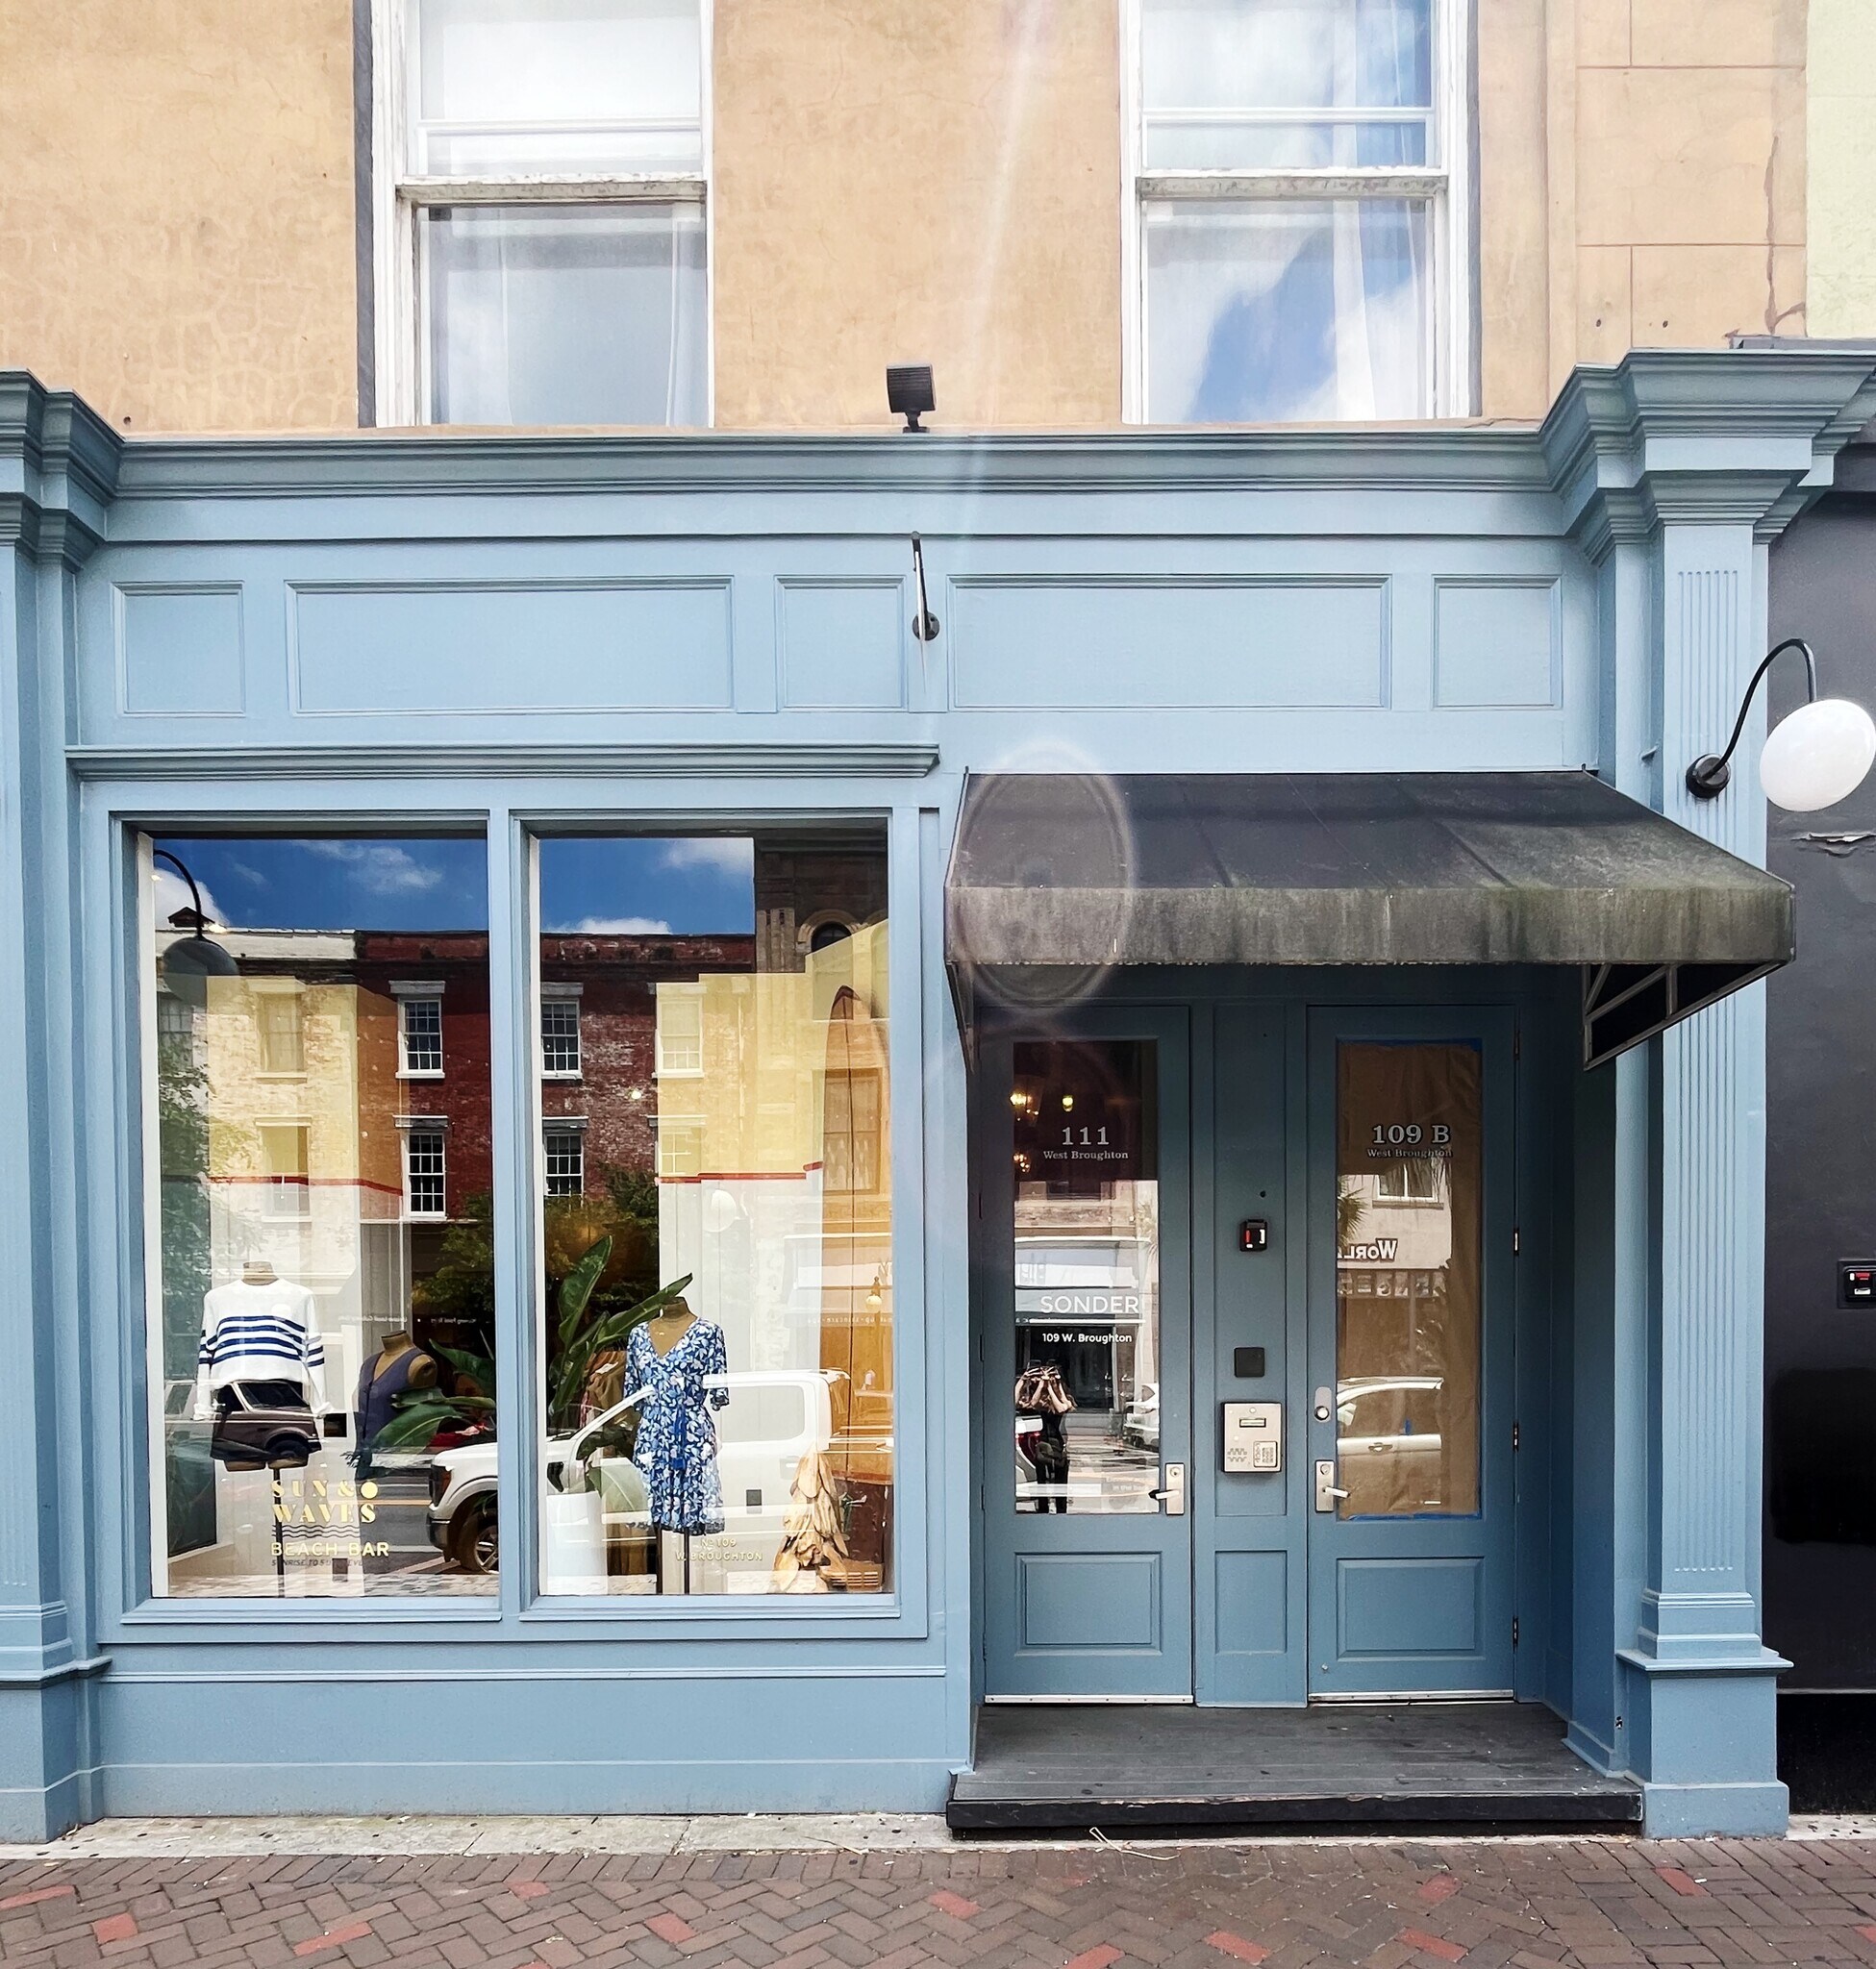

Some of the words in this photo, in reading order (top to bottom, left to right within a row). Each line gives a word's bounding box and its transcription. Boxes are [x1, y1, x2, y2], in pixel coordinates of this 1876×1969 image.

[1062, 1126, 1110, 1145] 111
[1373, 1124, 1422, 1144] 109
[1431, 1125, 1450, 1143] B
[1042, 1150, 1068, 1159] West
[1071, 1150, 1129, 1160] Broughton
[1366, 1149, 1392, 1158] West
[1395, 1149, 1453, 1159] Broughton
[1040, 1295, 1139, 1314] SONDER
[1041, 1333, 1060, 1342] 109
[1062, 1333, 1076, 1342] W.
[1078, 1333, 1133, 1345] Broughton
[271, 1480, 328, 1497] SUN
[338, 1480, 356, 1497] &
[272, 1503, 376, 1523] WAVES
[271, 1542, 338, 1556] BEACH
[348, 1541, 389, 1557] BAR
[716, 1538, 737, 1548] 109
[690, 1551, 763, 1561] BROUGHTON
